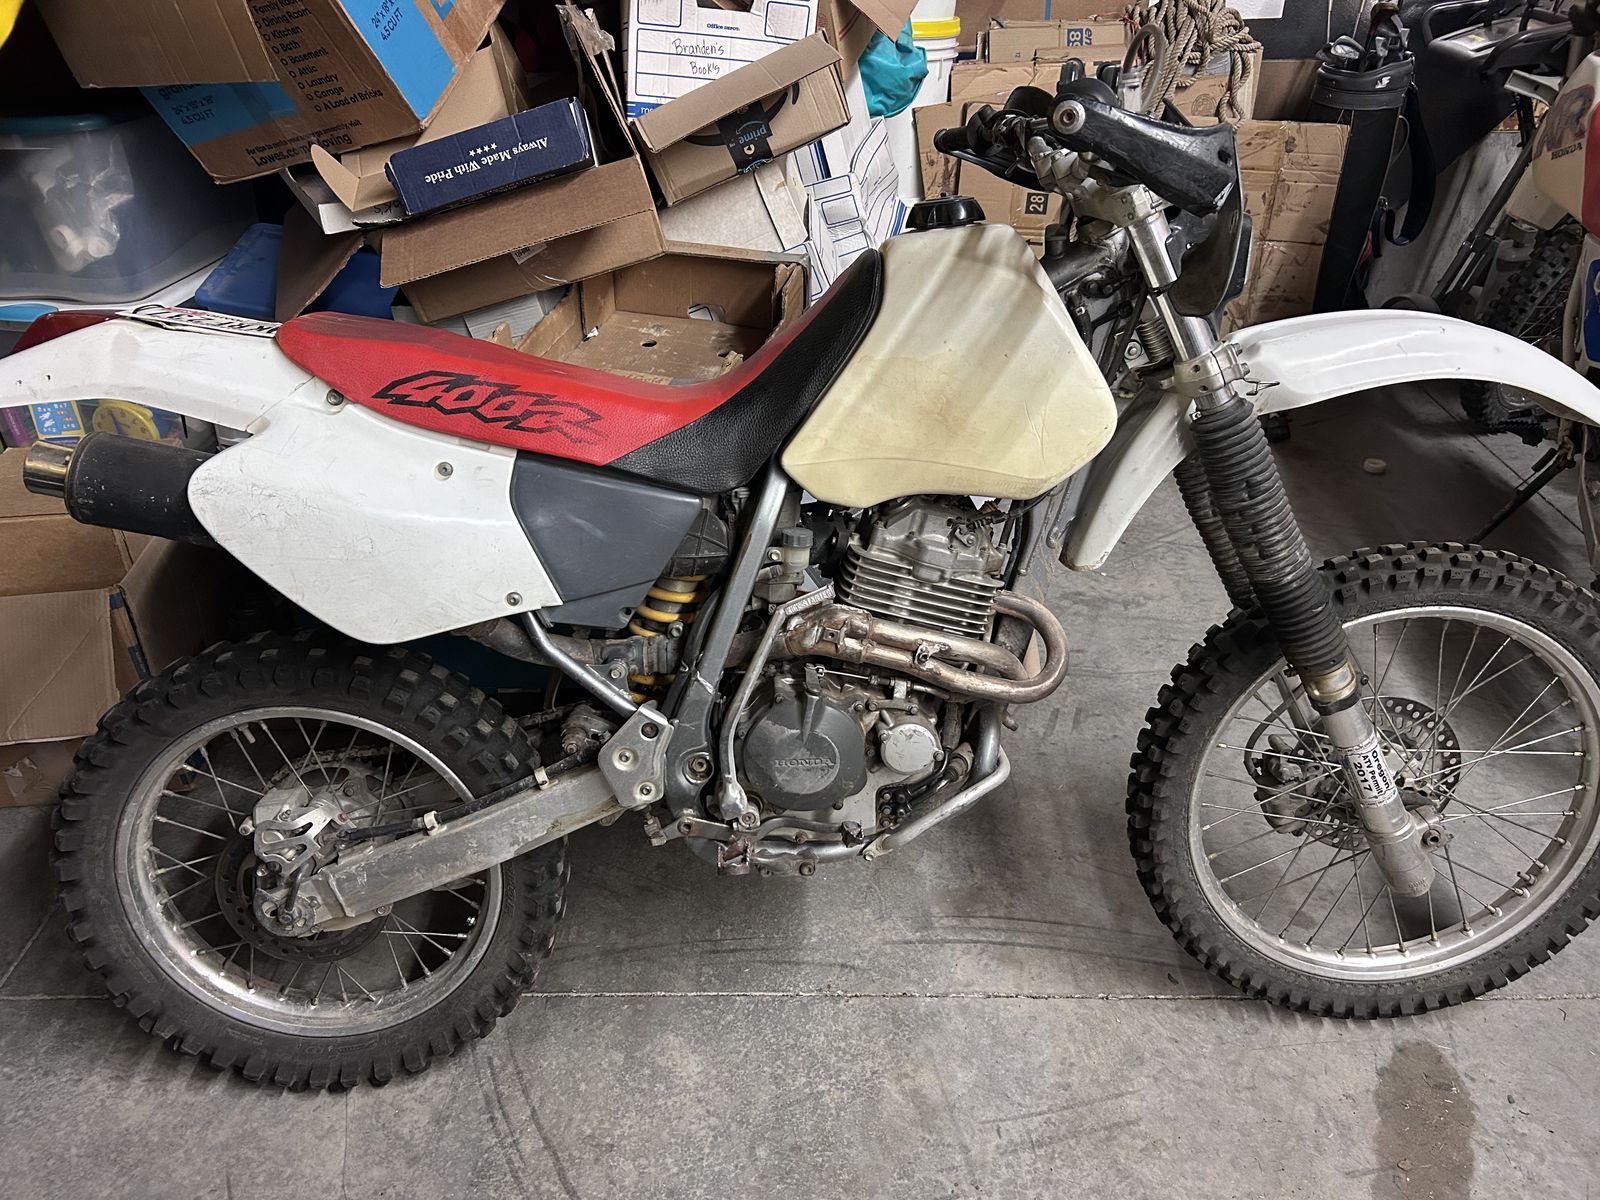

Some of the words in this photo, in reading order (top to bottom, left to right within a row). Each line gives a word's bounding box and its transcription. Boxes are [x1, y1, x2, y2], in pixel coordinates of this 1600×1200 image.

[261, 15, 290, 27] Dining
[286, 8, 311, 20] Room
[270, 26, 303, 40] Kitchen
[279, 40, 301, 52] Bath
[288, 47, 329, 63] Basement
[297, 65, 318, 77] Attic
[305, 73, 339, 88] Laundry
[314, 86, 345, 99] Garage
[330, 95, 351, 109] Load
[358, 88, 384, 101] Bricks
[739, 124, 767, 144] prime
[512, 136, 548, 155] Always
[1551, 142, 1583, 160] HONDA
[481, 148, 512, 165] Made
[424, 168, 454, 184] Pride
[453, 159, 481, 176] With
[1029, 195, 1045, 213] 28
[774, 757, 835, 769] HONDA
[1371, 750, 1391, 790] Oregon
[1353, 762, 1373, 792] 2017
[1361, 755, 1373, 769] ATV
[1369, 769, 1384, 795] Permit
